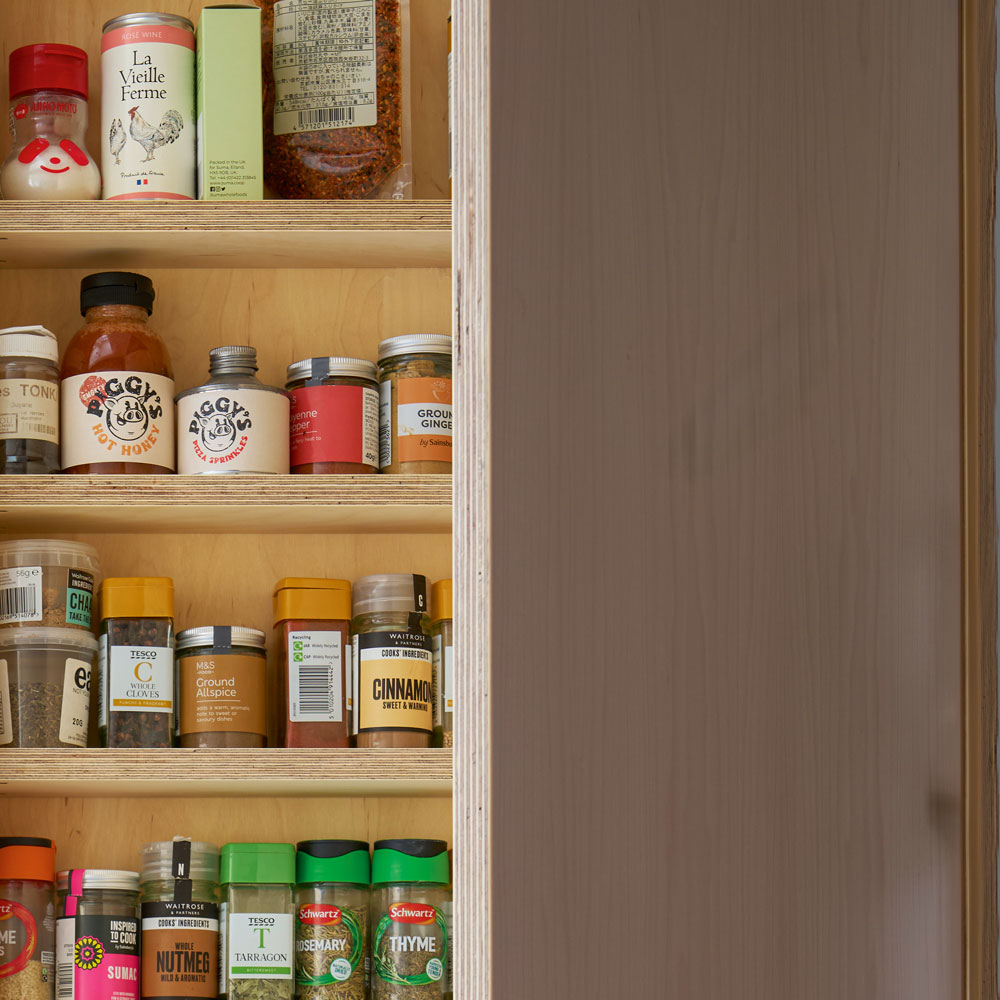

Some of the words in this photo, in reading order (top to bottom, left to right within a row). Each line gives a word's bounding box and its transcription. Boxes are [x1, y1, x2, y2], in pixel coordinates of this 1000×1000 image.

[142, 31, 163, 39] WINE
[132, 50, 152, 66] La
[119, 66, 165, 84] Vieille
[121, 85, 167, 102] Ferme
[87, 376, 163, 420] PIGGY'S
[189, 397, 252, 435] PIGGY'S
[421, 420, 453, 430] GINGE
[92, 423, 118, 451] HOT
[121, 423, 160, 456] HONEY
[192, 440, 207, 462] PIZZA
[209, 435, 248, 464] SPRINKLES
[16, 570, 31, 579] 56g
[418, 594, 424, 607] C
[69, 611, 82, 621] TAKE
[390, 633, 426, 642] WAITROSE
[402, 649, 429, 661] INGREDIENTS
[134, 661, 153, 683] C
[196, 661, 215, 671] M&S
[196, 677, 235, 688] Ground
[126, 690, 160, 699] CLOVES
[196, 687, 237, 699] Allspice
[382, 701, 402, 710] SWEET
[402, 702, 408, 710] &
[408, 703, 429, 712] WARMING
[178, 863, 185, 876] N
[165, 903, 205, 911] WAITROSE
[390, 907, 435, 918] Schwartz
[299, 908, 339, 920] Schwartz
[110, 920, 137, 932] INSPIRED
[177, 919, 210, 929] INGREDIENTS
[110, 931, 119, 940] TO
[120, 932, 137, 945] COOK
[253, 928, 271, 949] T
[389, 936, 436, 952] THYME
[175, 942, 195, 951] WHOLE
[296, 938, 346, 952] ROSEMARY
[156, 951, 210, 974] NUTMEG
[234, 952, 288, 962] TARRAGON
[107, 966, 138, 981] SUMAC
[160, 974, 174, 982] MILD
[174, 974, 180, 982] &
[180, 974, 206, 983] AROMATIC
